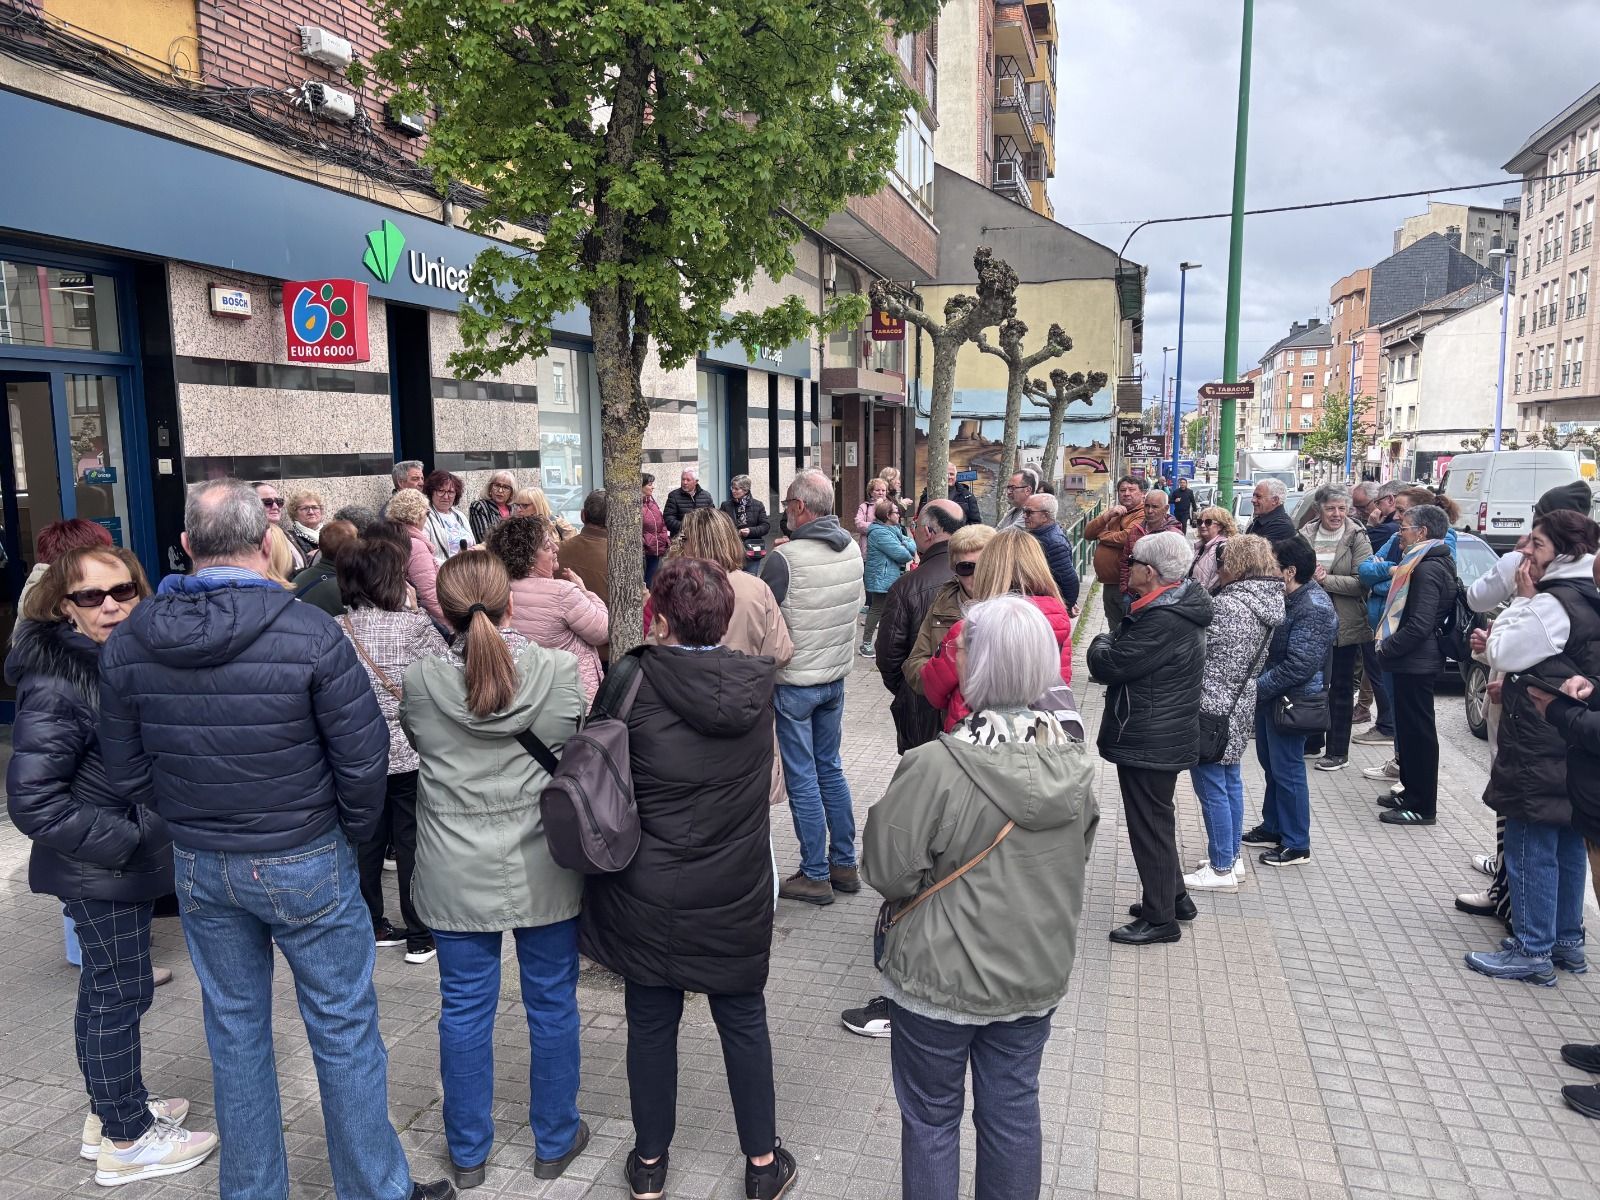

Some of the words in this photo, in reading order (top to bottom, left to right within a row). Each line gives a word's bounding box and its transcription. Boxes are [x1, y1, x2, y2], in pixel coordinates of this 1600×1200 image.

[222, 297, 248, 308] BOSCH
[290, 345, 321, 357] EURO
[323, 345, 355, 356] 6000
